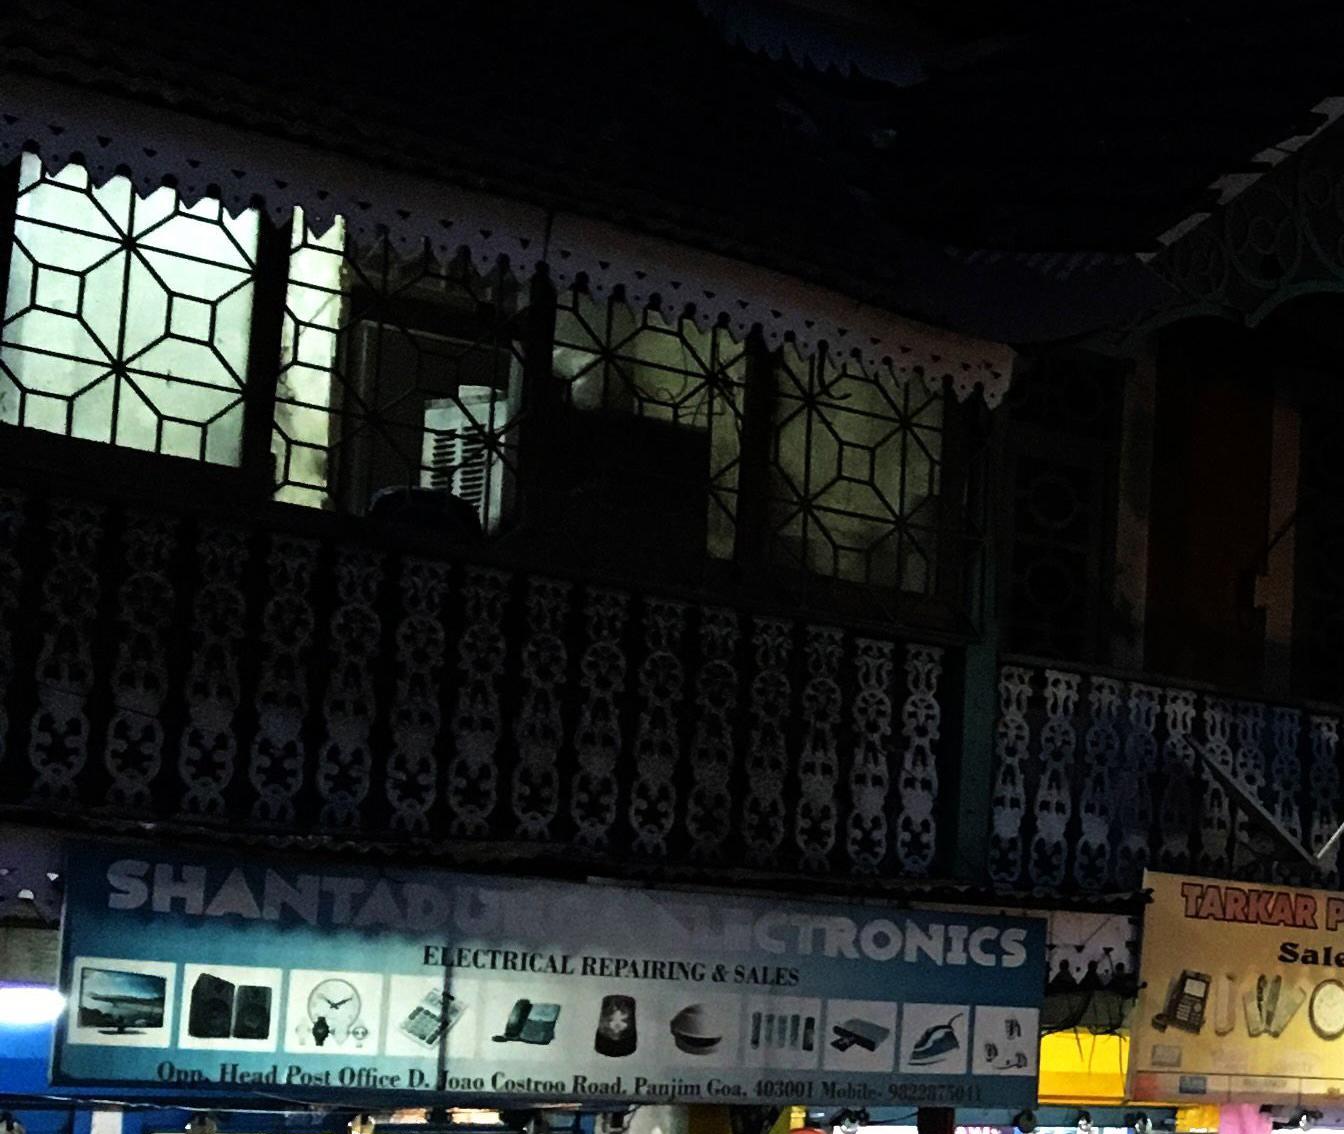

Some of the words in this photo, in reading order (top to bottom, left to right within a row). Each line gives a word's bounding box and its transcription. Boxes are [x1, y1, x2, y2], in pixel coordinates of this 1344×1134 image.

[107, 859, 634, 943] SHANTADU
[657, 904, 1027, 967] LECTRONICS
[1181, 882, 1318, 930] TARKAR
[423, 945, 575, 976] ELECTRICAL
[581, 957, 706, 983] REPAIRING
[711, 964, 729, 984] &
[734, 964, 800, 987] SALES
[220, 1063, 278, 1085] Head
[286, 1065, 331, 1086] Post
[338, 1066, 400, 1088] Office
[409, 1068, 430, 1089] D.
[634, 1077, 700, 1101] Panjim
